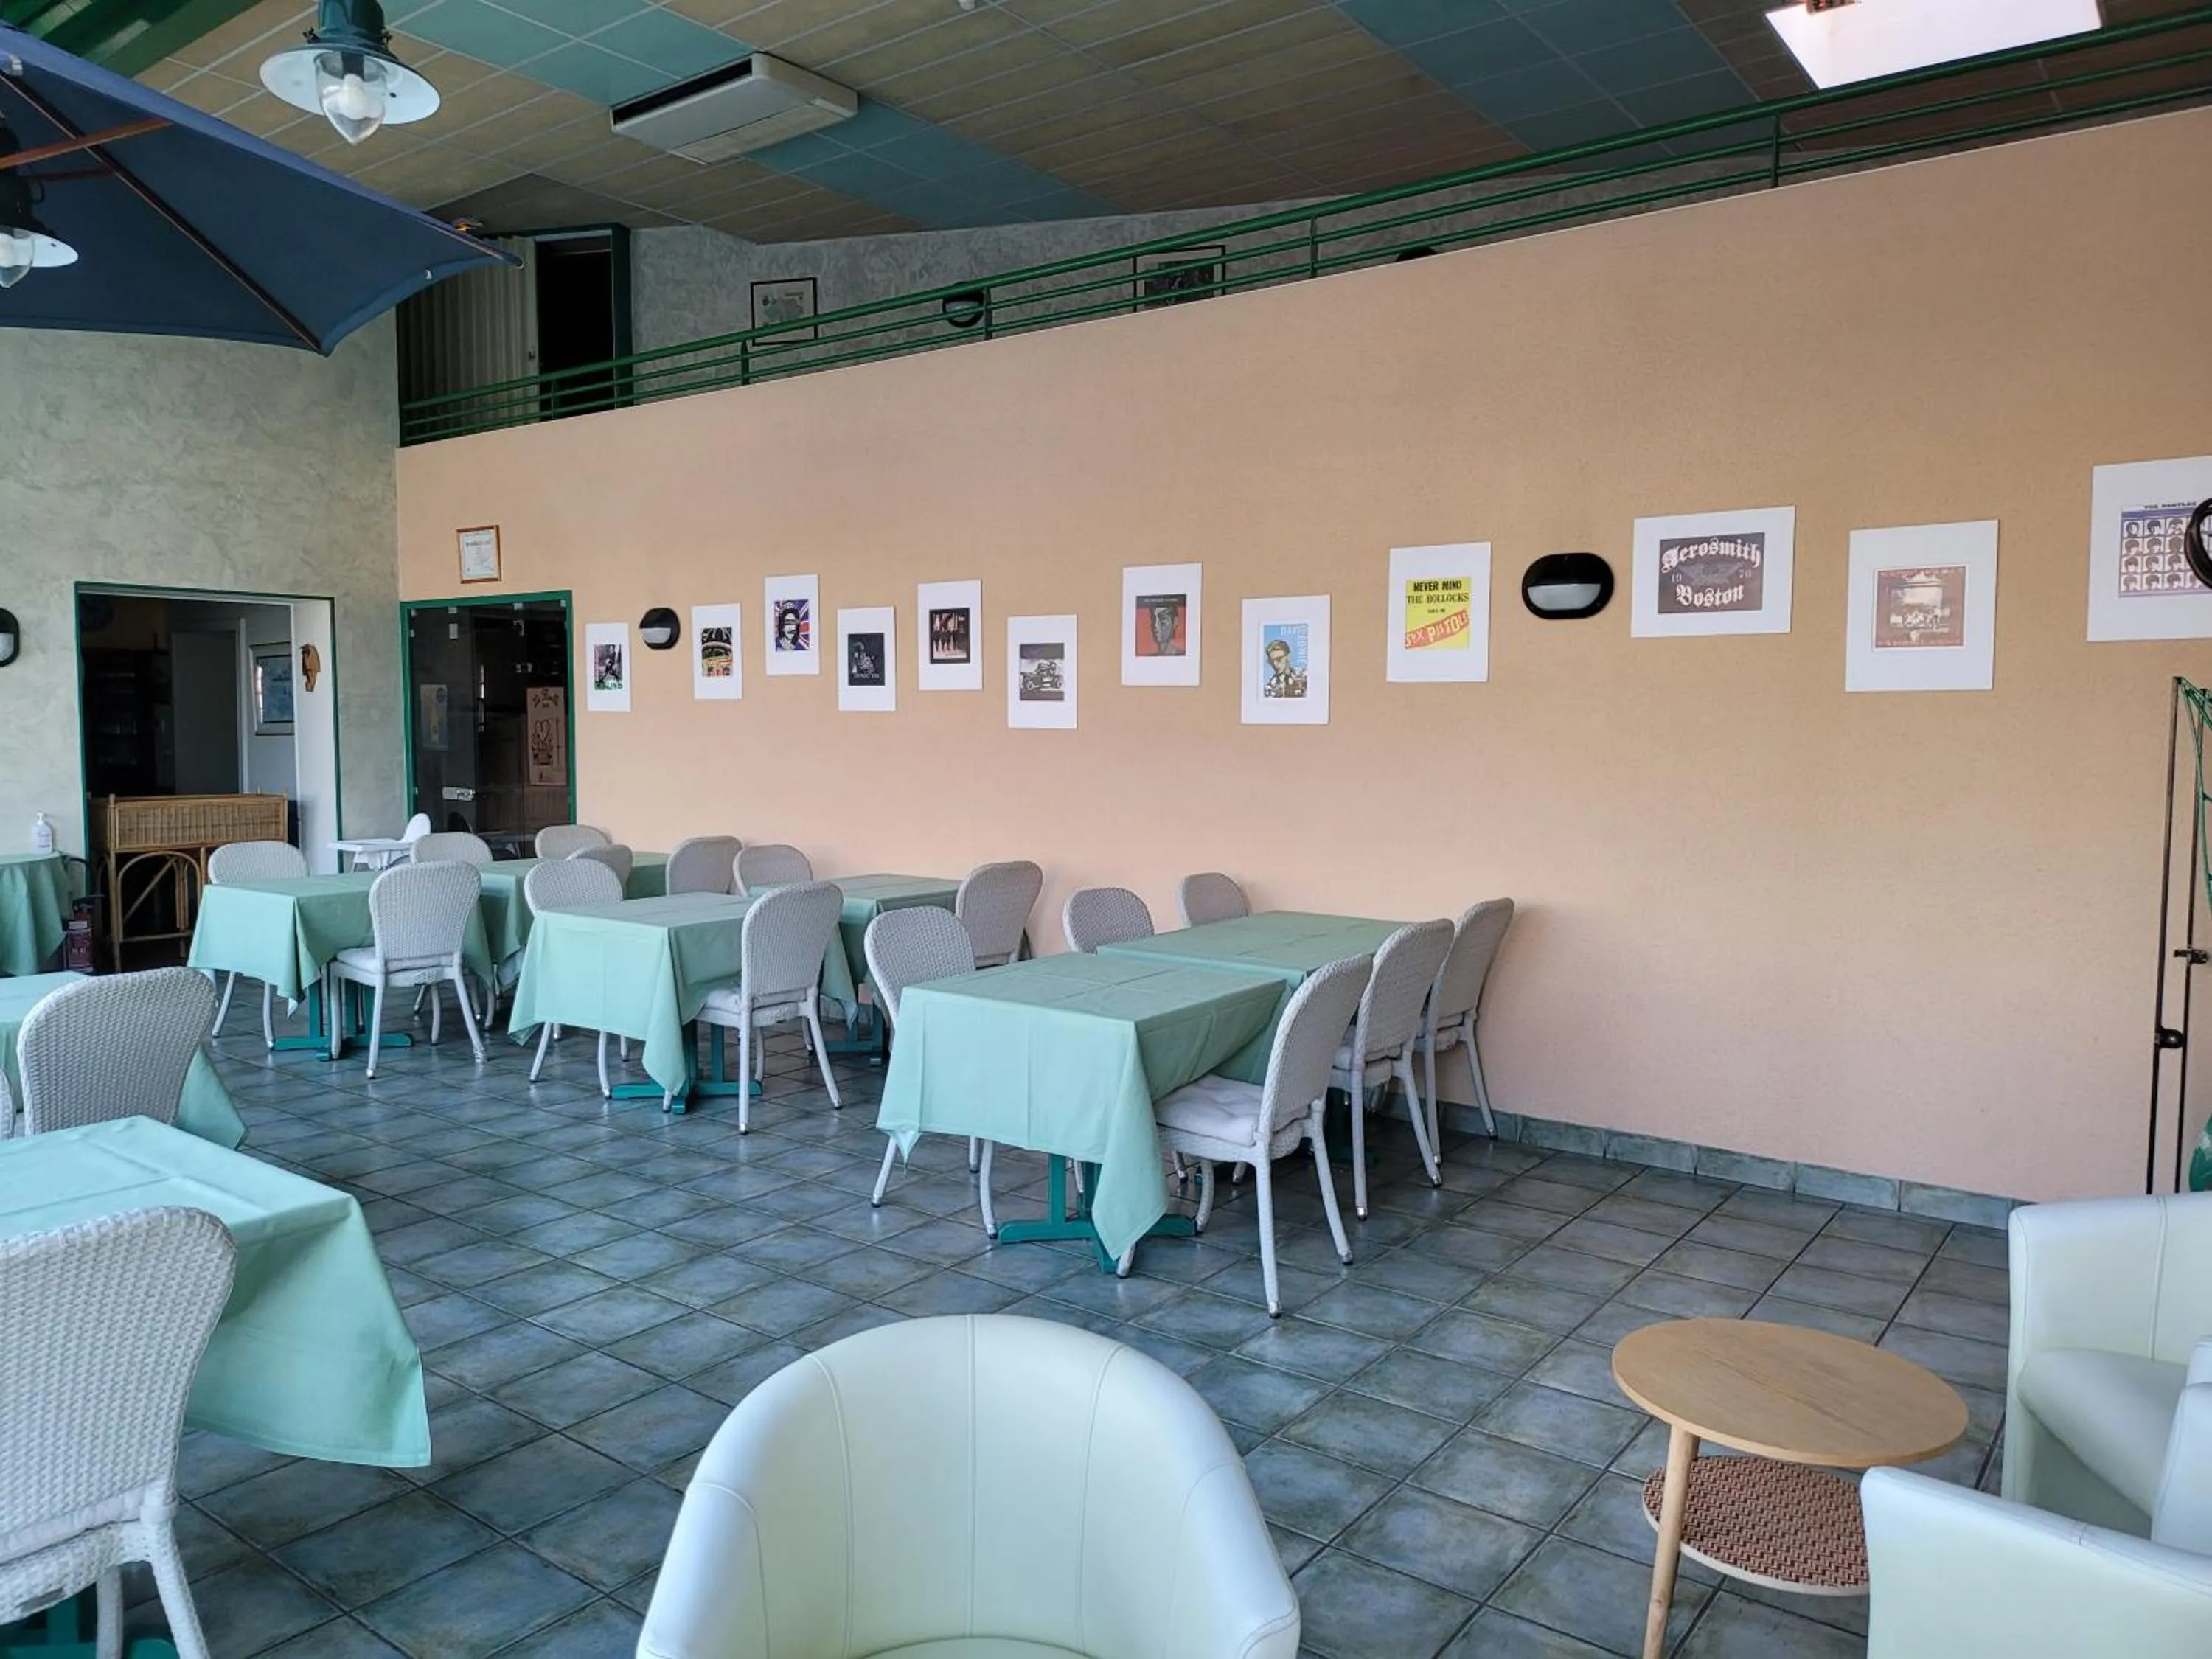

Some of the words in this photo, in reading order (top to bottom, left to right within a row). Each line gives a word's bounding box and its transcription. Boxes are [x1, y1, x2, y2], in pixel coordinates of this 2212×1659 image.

[1662, 538, 1761, 573] Aerosmith
[1413, 580, 1439, 591] NEVER
[1441, 580, 1462, 591] MIND
[1407, 595, 1422, 604] THE
[1675, 584, 1745, 607] Boston
